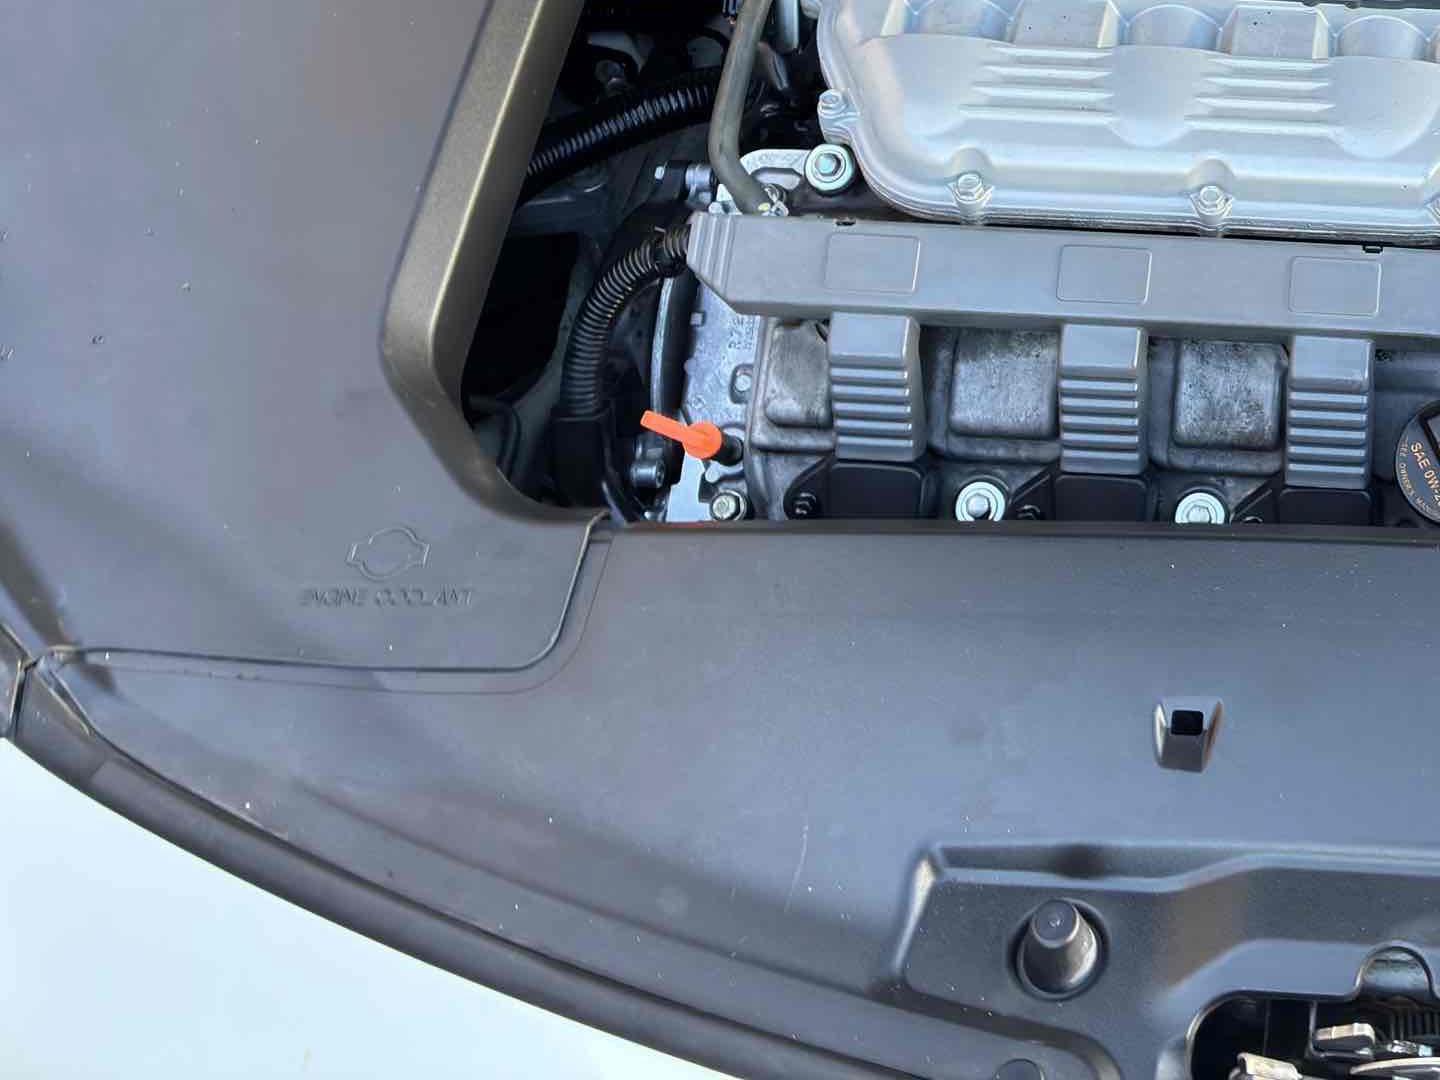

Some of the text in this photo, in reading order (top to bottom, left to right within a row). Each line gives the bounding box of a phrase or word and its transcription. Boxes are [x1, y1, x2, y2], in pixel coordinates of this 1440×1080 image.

[1410, 441, 1432, 469] SAE
[299, 585, 474, 607] ENGINE COOLANT
